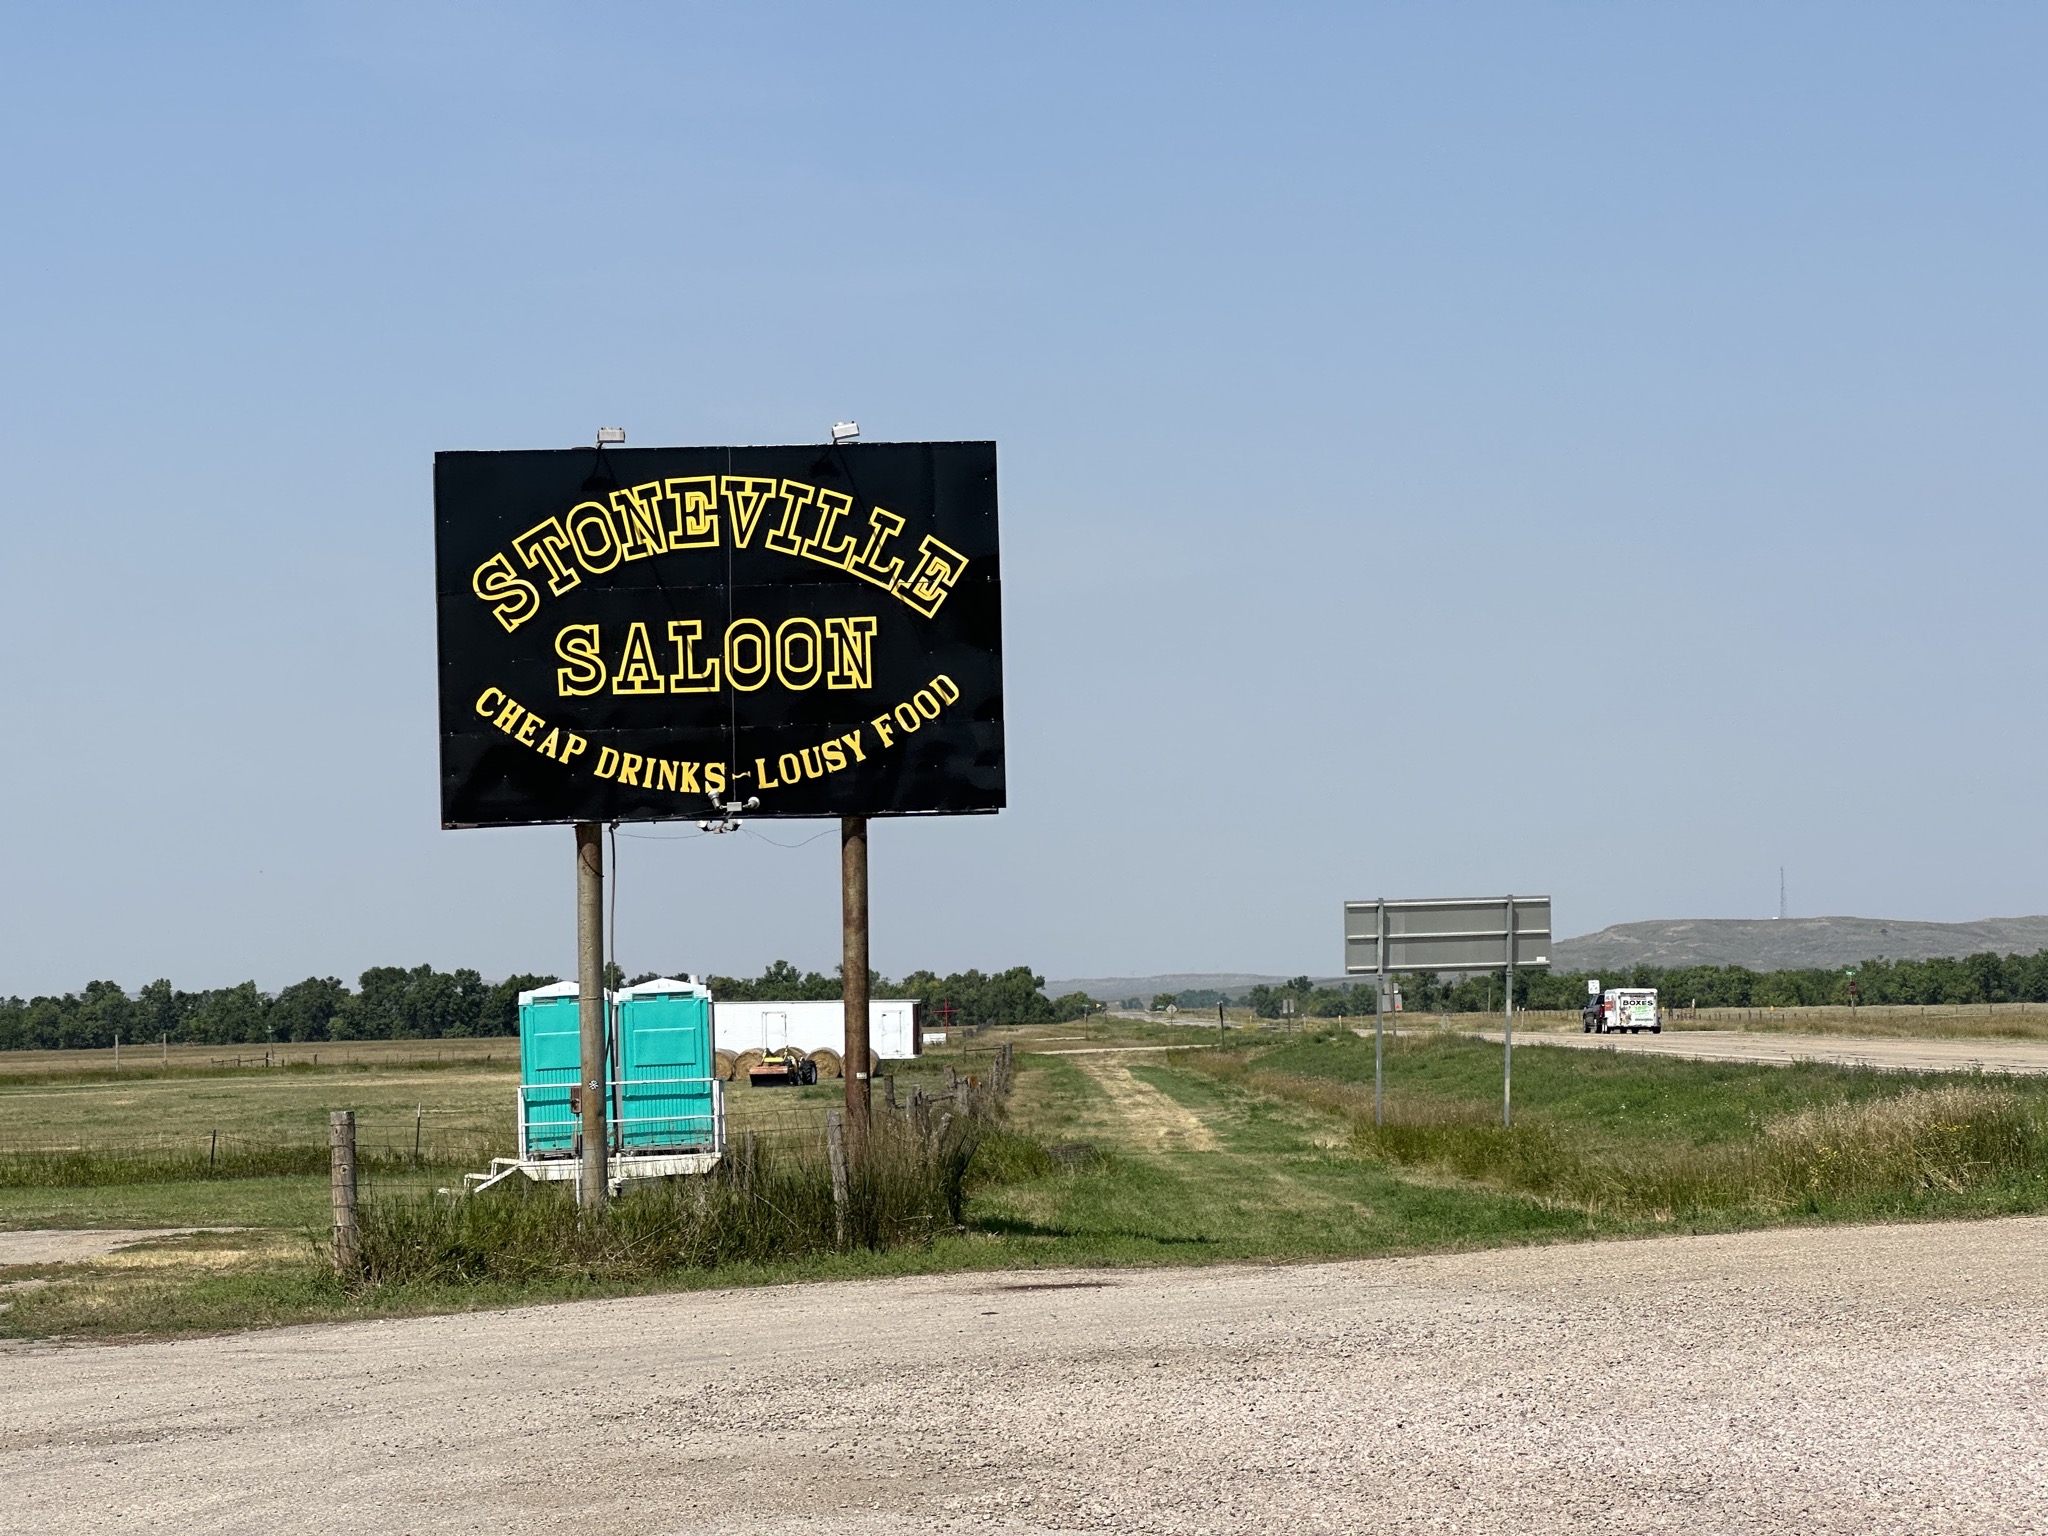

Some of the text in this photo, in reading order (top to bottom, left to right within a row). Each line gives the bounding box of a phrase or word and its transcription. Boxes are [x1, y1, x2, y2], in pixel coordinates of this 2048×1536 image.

[472, 475, 969, 633] STONEVILLE
[555, 616, 878, 696] SALOON
[475, 686, 588, 765] CHEAP
[594, 746, 726, 794] DRINKS
[755, 730, 866, 790] LOUSY
[871, 674, 961, 748] FOOD
